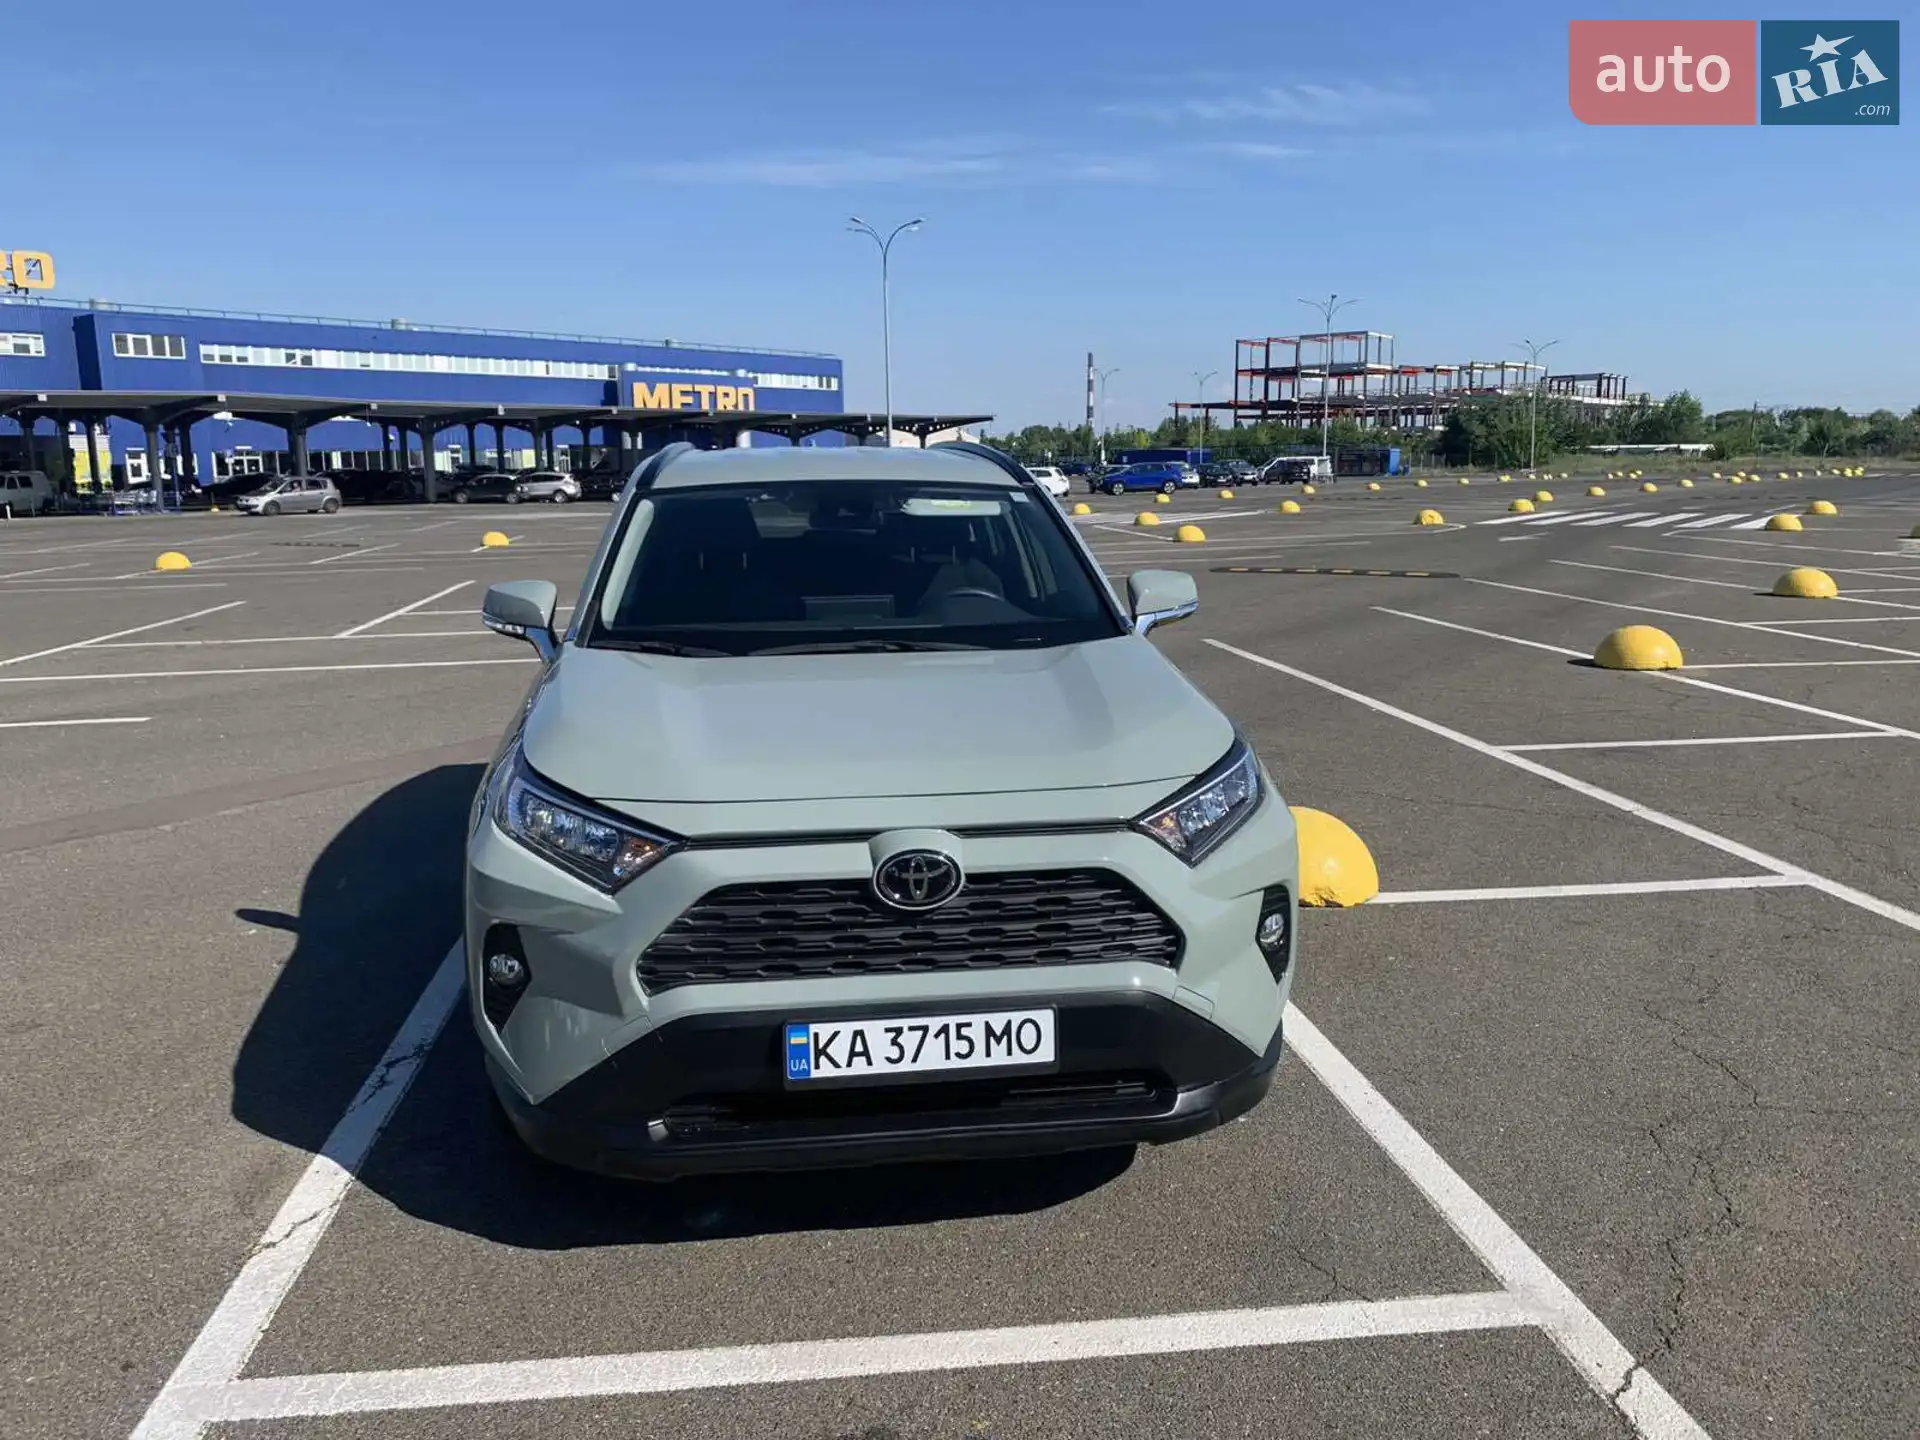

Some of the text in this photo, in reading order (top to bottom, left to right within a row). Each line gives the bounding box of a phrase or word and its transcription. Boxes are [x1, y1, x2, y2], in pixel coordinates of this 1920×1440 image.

[0, 249, 55, 289] O
[632, 382, 755, 411] METRO
[813, 1018, 1042, 1070] KA 3715 MO
[790, 1060, 808, 1071] UA
